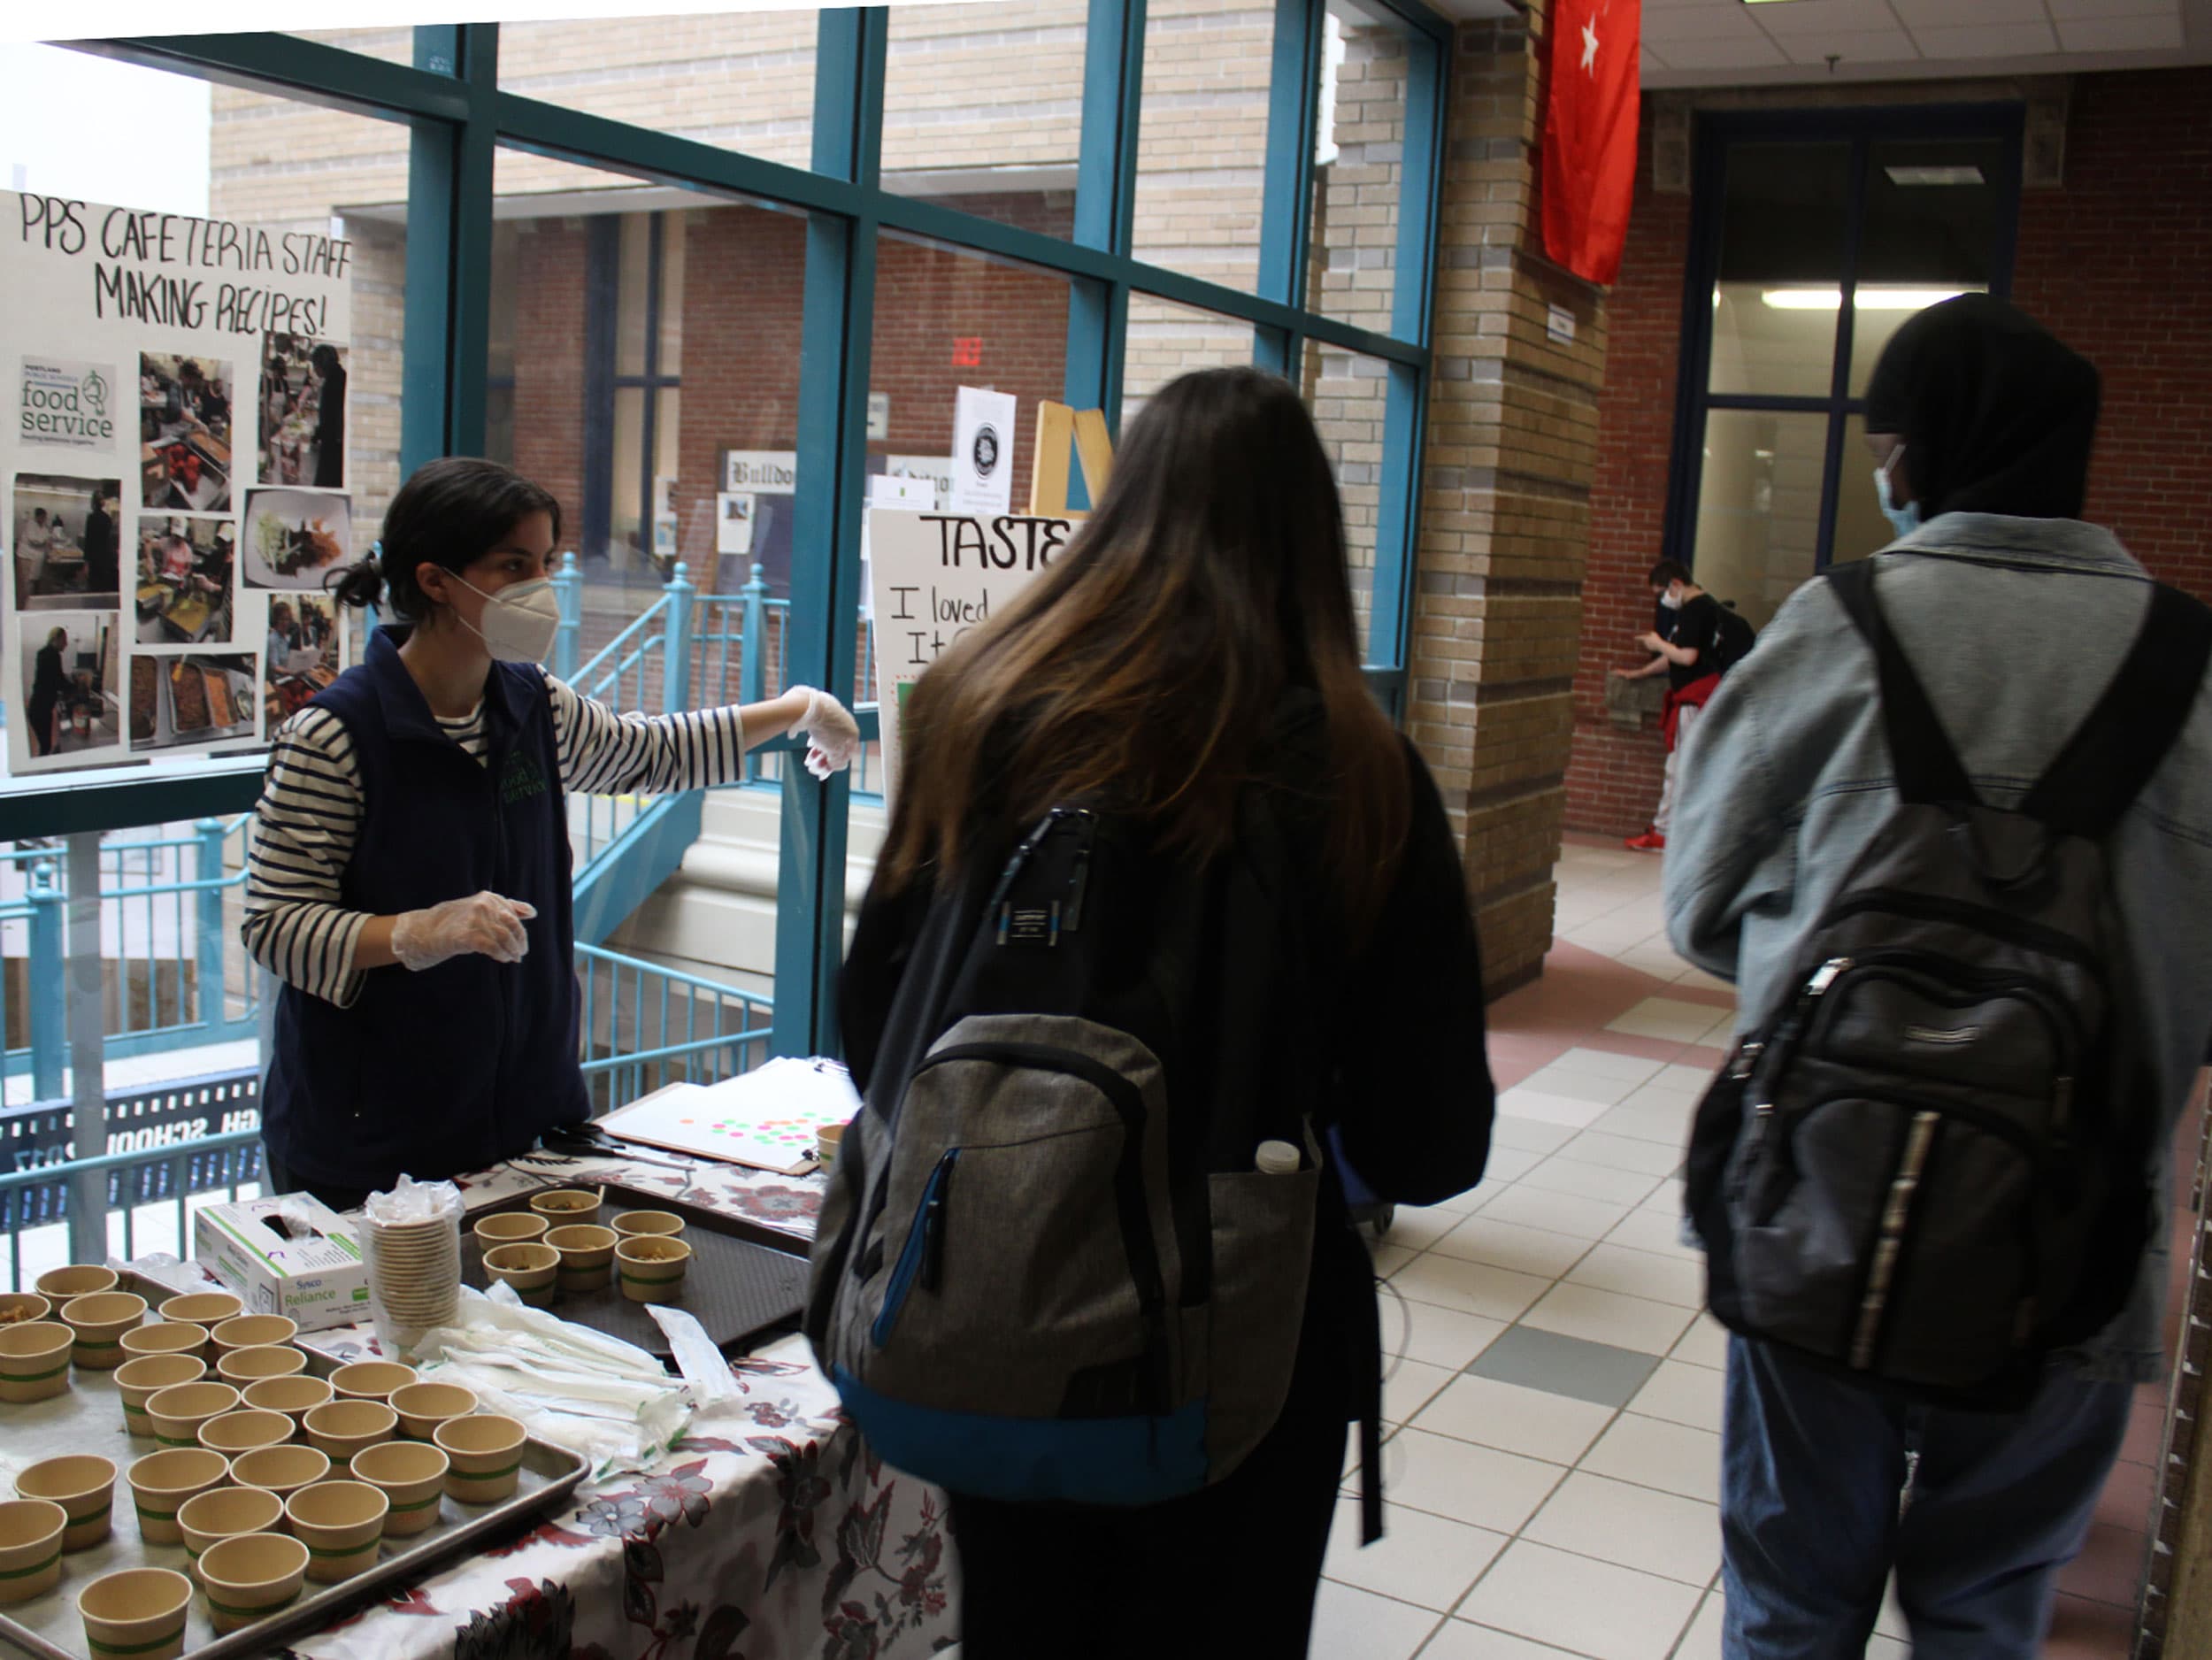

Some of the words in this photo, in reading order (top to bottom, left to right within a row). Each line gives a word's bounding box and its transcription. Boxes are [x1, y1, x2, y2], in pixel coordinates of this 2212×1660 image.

[19, 193, 87, 255] PPS
[102, 207, 273, 271] CAFETERIA
[283, 233, 353, 279] STAFF
[95, 263, 209, 329] MAKING
[216, 284, 326, 335] RECIPES!
[22, 380, 79, 411] food
[22, 411, 113, 438] service
[732, 462, 794, 485] Bulldo
[889, 587, 919, 619] I
[932, 586, 989, 624] loved
[907, 630, 946, 664] It
[284, 1289, 337, 1308] Reliance
[296, 1279, 322, 1291] Sysco
